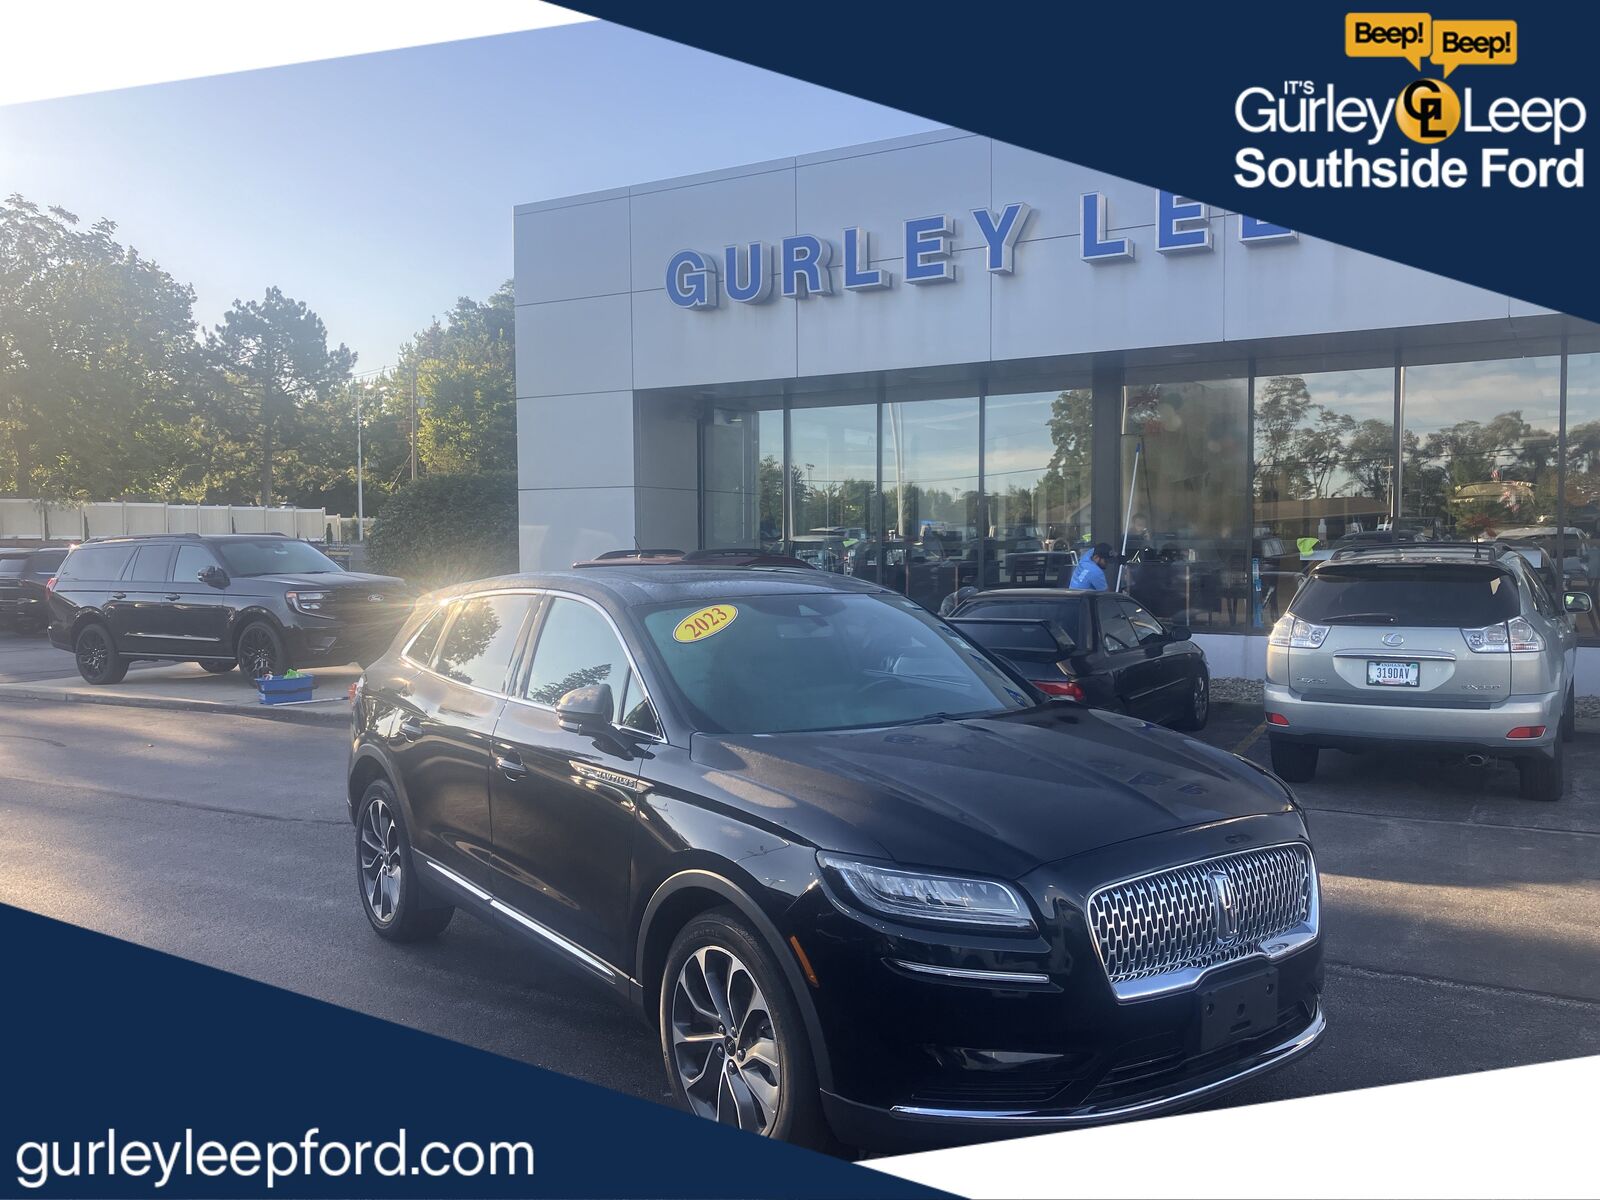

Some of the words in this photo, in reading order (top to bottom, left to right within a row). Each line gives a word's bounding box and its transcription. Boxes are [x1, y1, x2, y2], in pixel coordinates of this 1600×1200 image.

[665, 202, 1032, 311] GURLEY
[1080, 187, 1297, 263] LE
[684, 607, 728, 638] 2023
